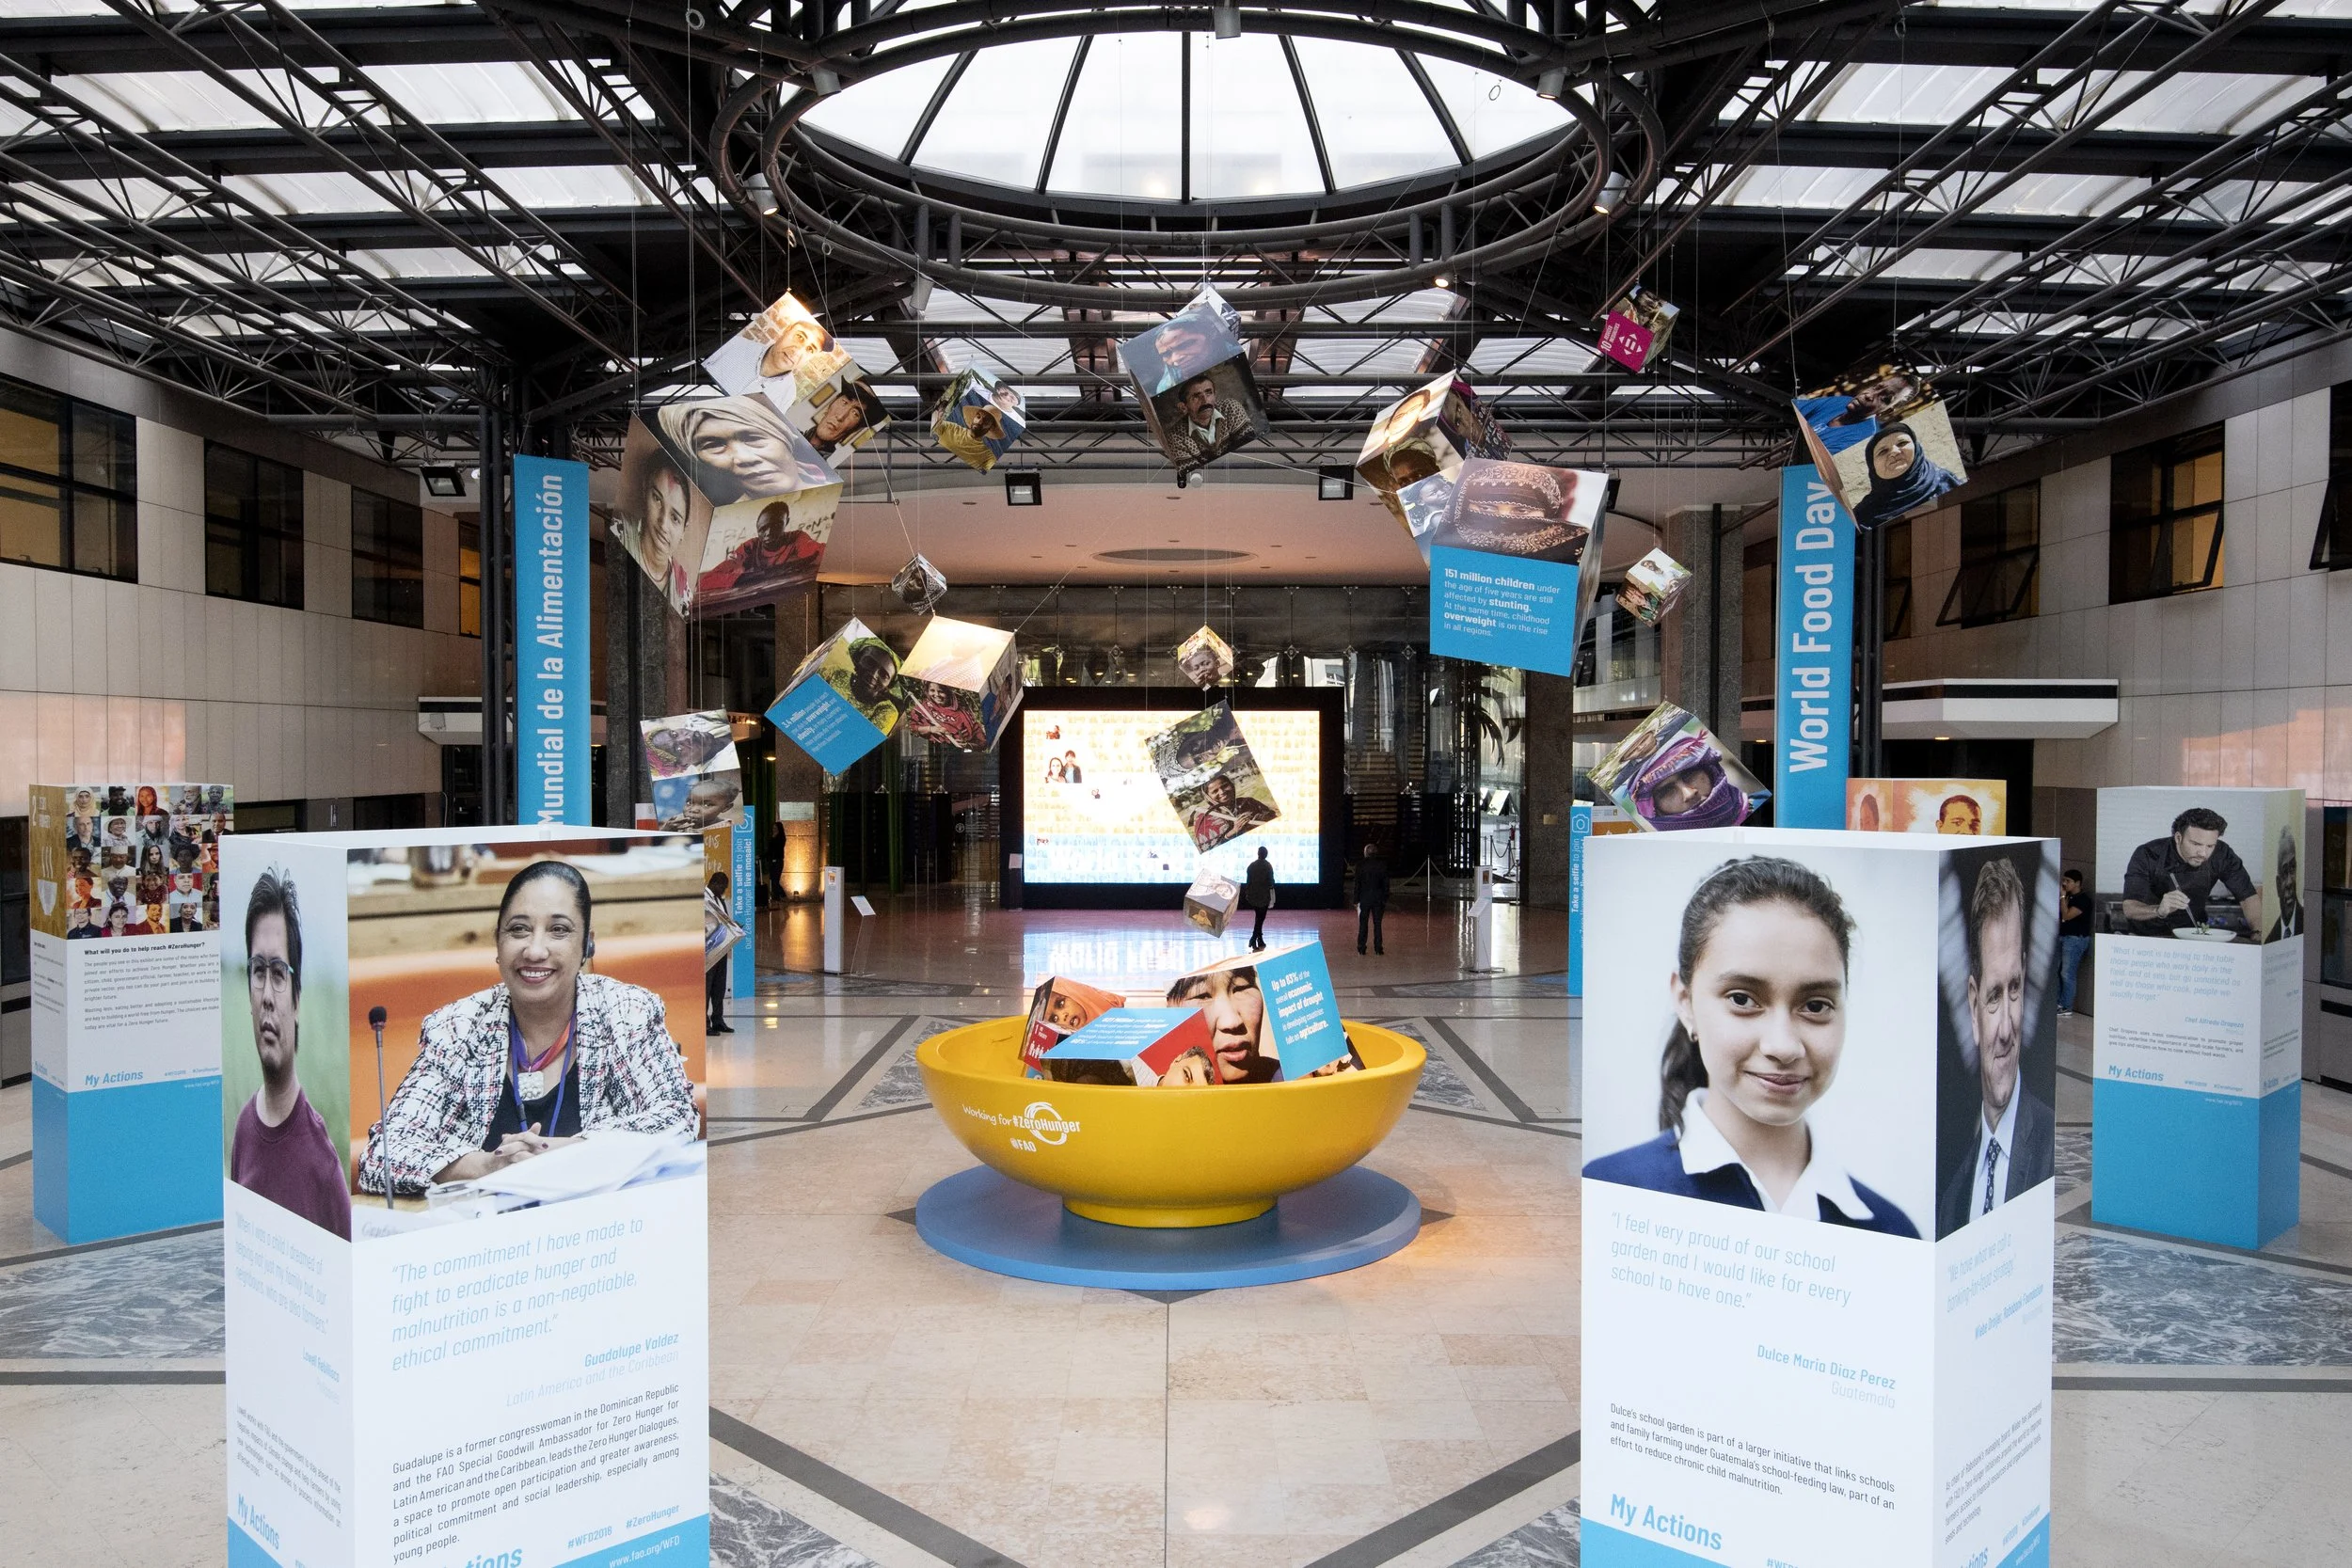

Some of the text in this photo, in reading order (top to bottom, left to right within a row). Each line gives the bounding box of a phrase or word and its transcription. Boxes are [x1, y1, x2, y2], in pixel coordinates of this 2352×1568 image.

[1601, 341, 1612, 351] 10
[1445, 569, 1457, 578] 151
[1460, 573, 1492, 583] million
[1495, 578, 1534, 590] children
[1444, 593, 1532, 612] affected by stunting.
[1485, 587, 1499, 595] five
[1501, 591, 1522, 599] years
[1444, 611, 1496, 627] overweight
[1518, 624, 1531, 632] the
[1454, 603, 1466, 611] the
[1469, 607, 1488, 615] same
[1512, 613, 1549, 625] childhood
[1789, 482, 1835, 772] World Food Day
[1464, 627, 1493, 637] regions.
[535, 475, 564, 825] Mundial de la Alimentación
[790, 709, 806, 722] million
[806, 702, 831, 722] overweight
[736, 838, 744, 852] join
[743, 839, 752, 870] mosaic!
[735, 895, 743, 915] Take
[744, 889, 753, 915] Hunger
[1271, 980, 1279, 991] Up
[1279, 978, 1286, 988] to
[1286, 973, 1298, 985] 83%
[1288, 982, 1312, 999] economic
[1279, 991, 1324, 1017] impact of drought
[1299, 1021, 1328, 1039] agriculture.
[85, 1075, 100, 1087] My
[103, 1071, 143, 1084] Actions
[2108, 1065, 2164, 1082] My Actions
[961, 1103, 1081, 1133] Working for #ZeroHunger
[1010, 1138, 1036, 1152] @FAO
[433, 1241, 531, 1275] commitment
[537, 1237, 541, 1253] I
[547, 1232, 580, 1251] have
[586, 1221, 625, 1243] made
[630, 1219, 643, 1233] to
[1626, 1214, 1650, 1234] feel
[1655, 1225, 1684, 1245] very
[1688, 1231, 1729, 1251] proud
[1735, 1238, 1750, 1255] of
[1755, 1245, 1780, 1260] our
[1785, 1250, 1836, 1272] school
[392, 1247, 617, 1316] fight to eradicate hunger and
[1611, 1266, 1655, 1287] school
[1660, 1275, 1673, 1291] to
[1677, 1278, 1710, 1300] have
[1612, 1242, 1851, 1307] garden and I would like for every
[392, 1307, 488, 1341] malnutrition
[495, 1300, 507, 1317] is
[513, 1300, 522, 1313] a
[392, 1341, 447, 1370] ethical
[585, 1334, 679, 1367] Guadalupe Valdez
[1757, 1345, 1896, 1389] Dulce Maria Diaz Perez
[1830, 1381, 1896, 1408] Guatemala
[393, 1385, 679, 1474] Guadalupe is a former congresswoman in the Dominican Republic
[237, 1494, 279, 1550] My Actions
[626, 1505, 679, 1528] #ZeroHunger
[1611, 1494, 1722, 1550] My Actions
[568, 1526, 612, 1548] #WFD2018
[610, 1535, 679, 1568] www.fao.org/WFD
